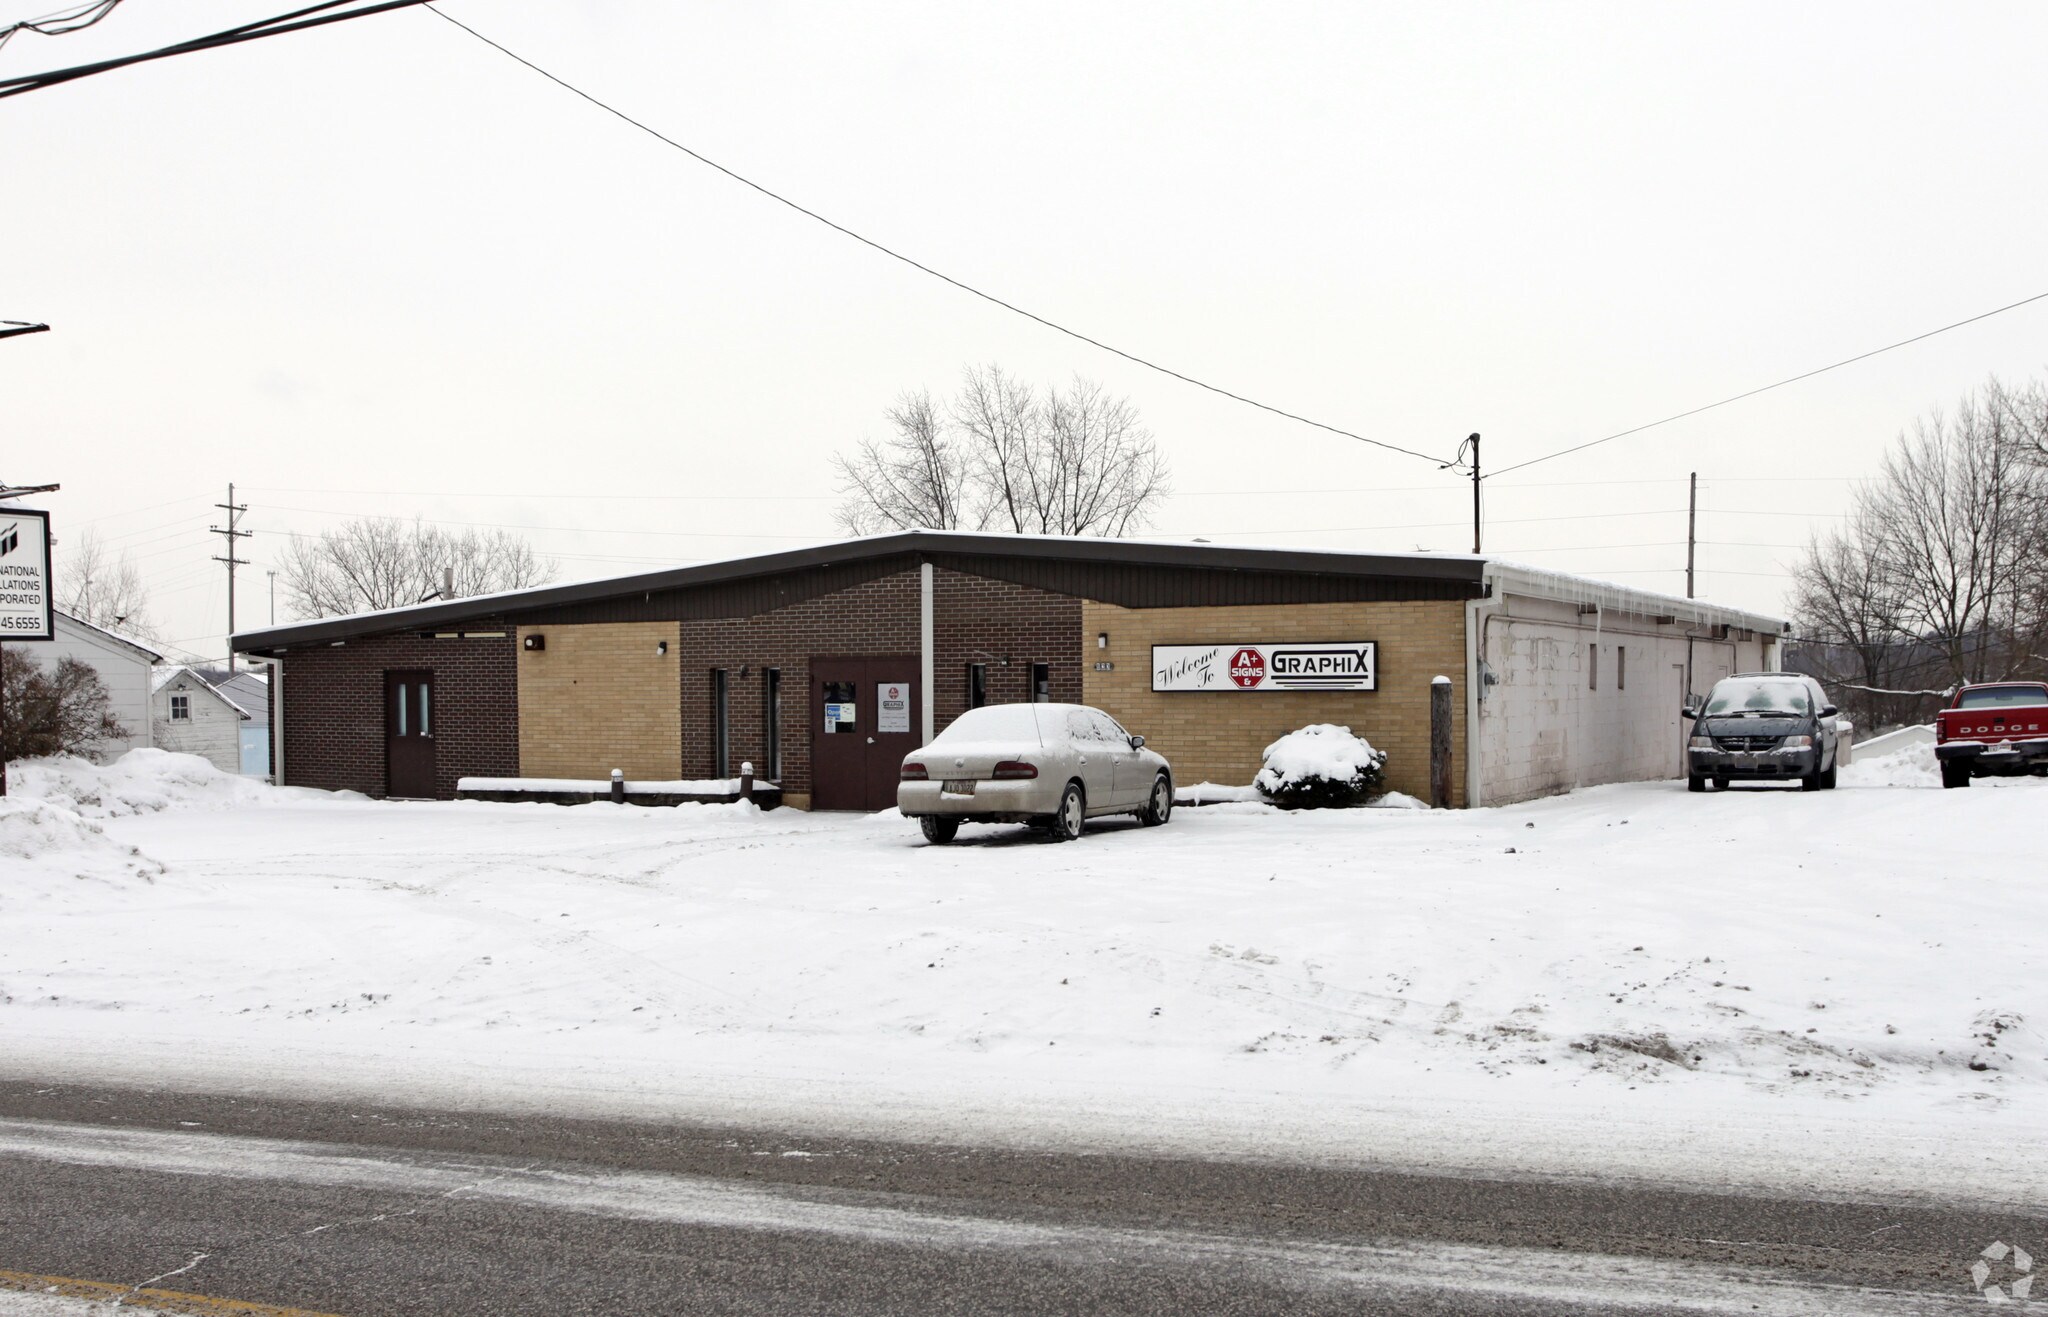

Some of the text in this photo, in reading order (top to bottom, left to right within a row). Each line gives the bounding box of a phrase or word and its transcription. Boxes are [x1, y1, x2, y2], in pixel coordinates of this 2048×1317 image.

[0, 580, 40, 590] LATIONS
[1237, 652, 1258, 667] A+
[1271, 650, 1368, 673] GRAPHIX
[1156, 647, 1219, 688] Welcome
[1231, 667, 1263, 677] SIGNS
[1196, 664, 1215, 688] To
[1243, 678, 1252, 686] &
[1960, 724, 2039, 733] DODGE
